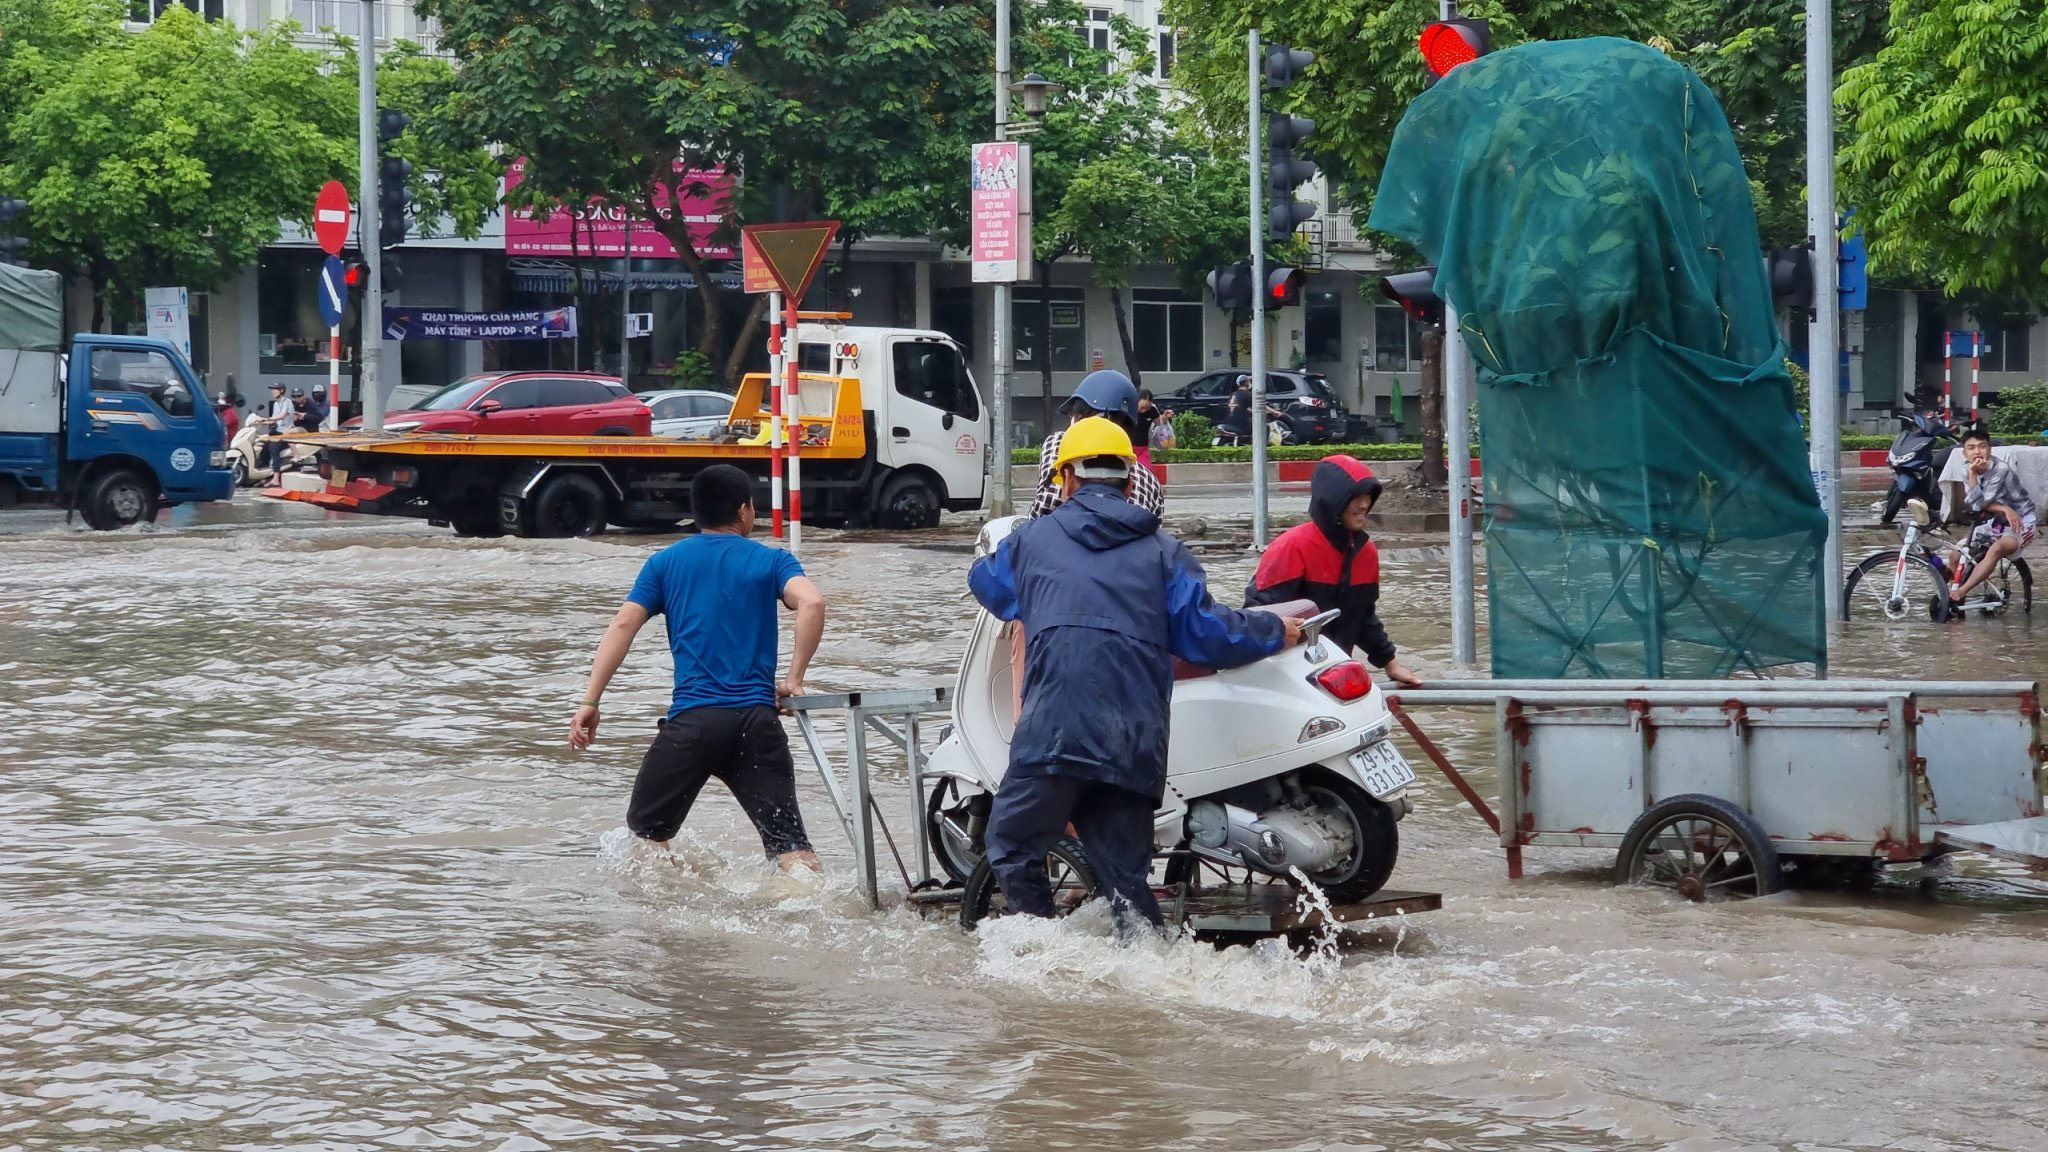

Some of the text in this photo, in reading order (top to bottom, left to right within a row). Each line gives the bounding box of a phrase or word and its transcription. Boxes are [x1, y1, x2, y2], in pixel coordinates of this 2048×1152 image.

[421, 312, 446, 322] KHAI
[425, 324, 446, 336] MÁY
[479, 326, 517, 336] LAPTOP
[524, 325, 538, 335] PC
[1356, 742, 1396, 773] 29-X5
[1366, 760, 1413, 794] 331.91
